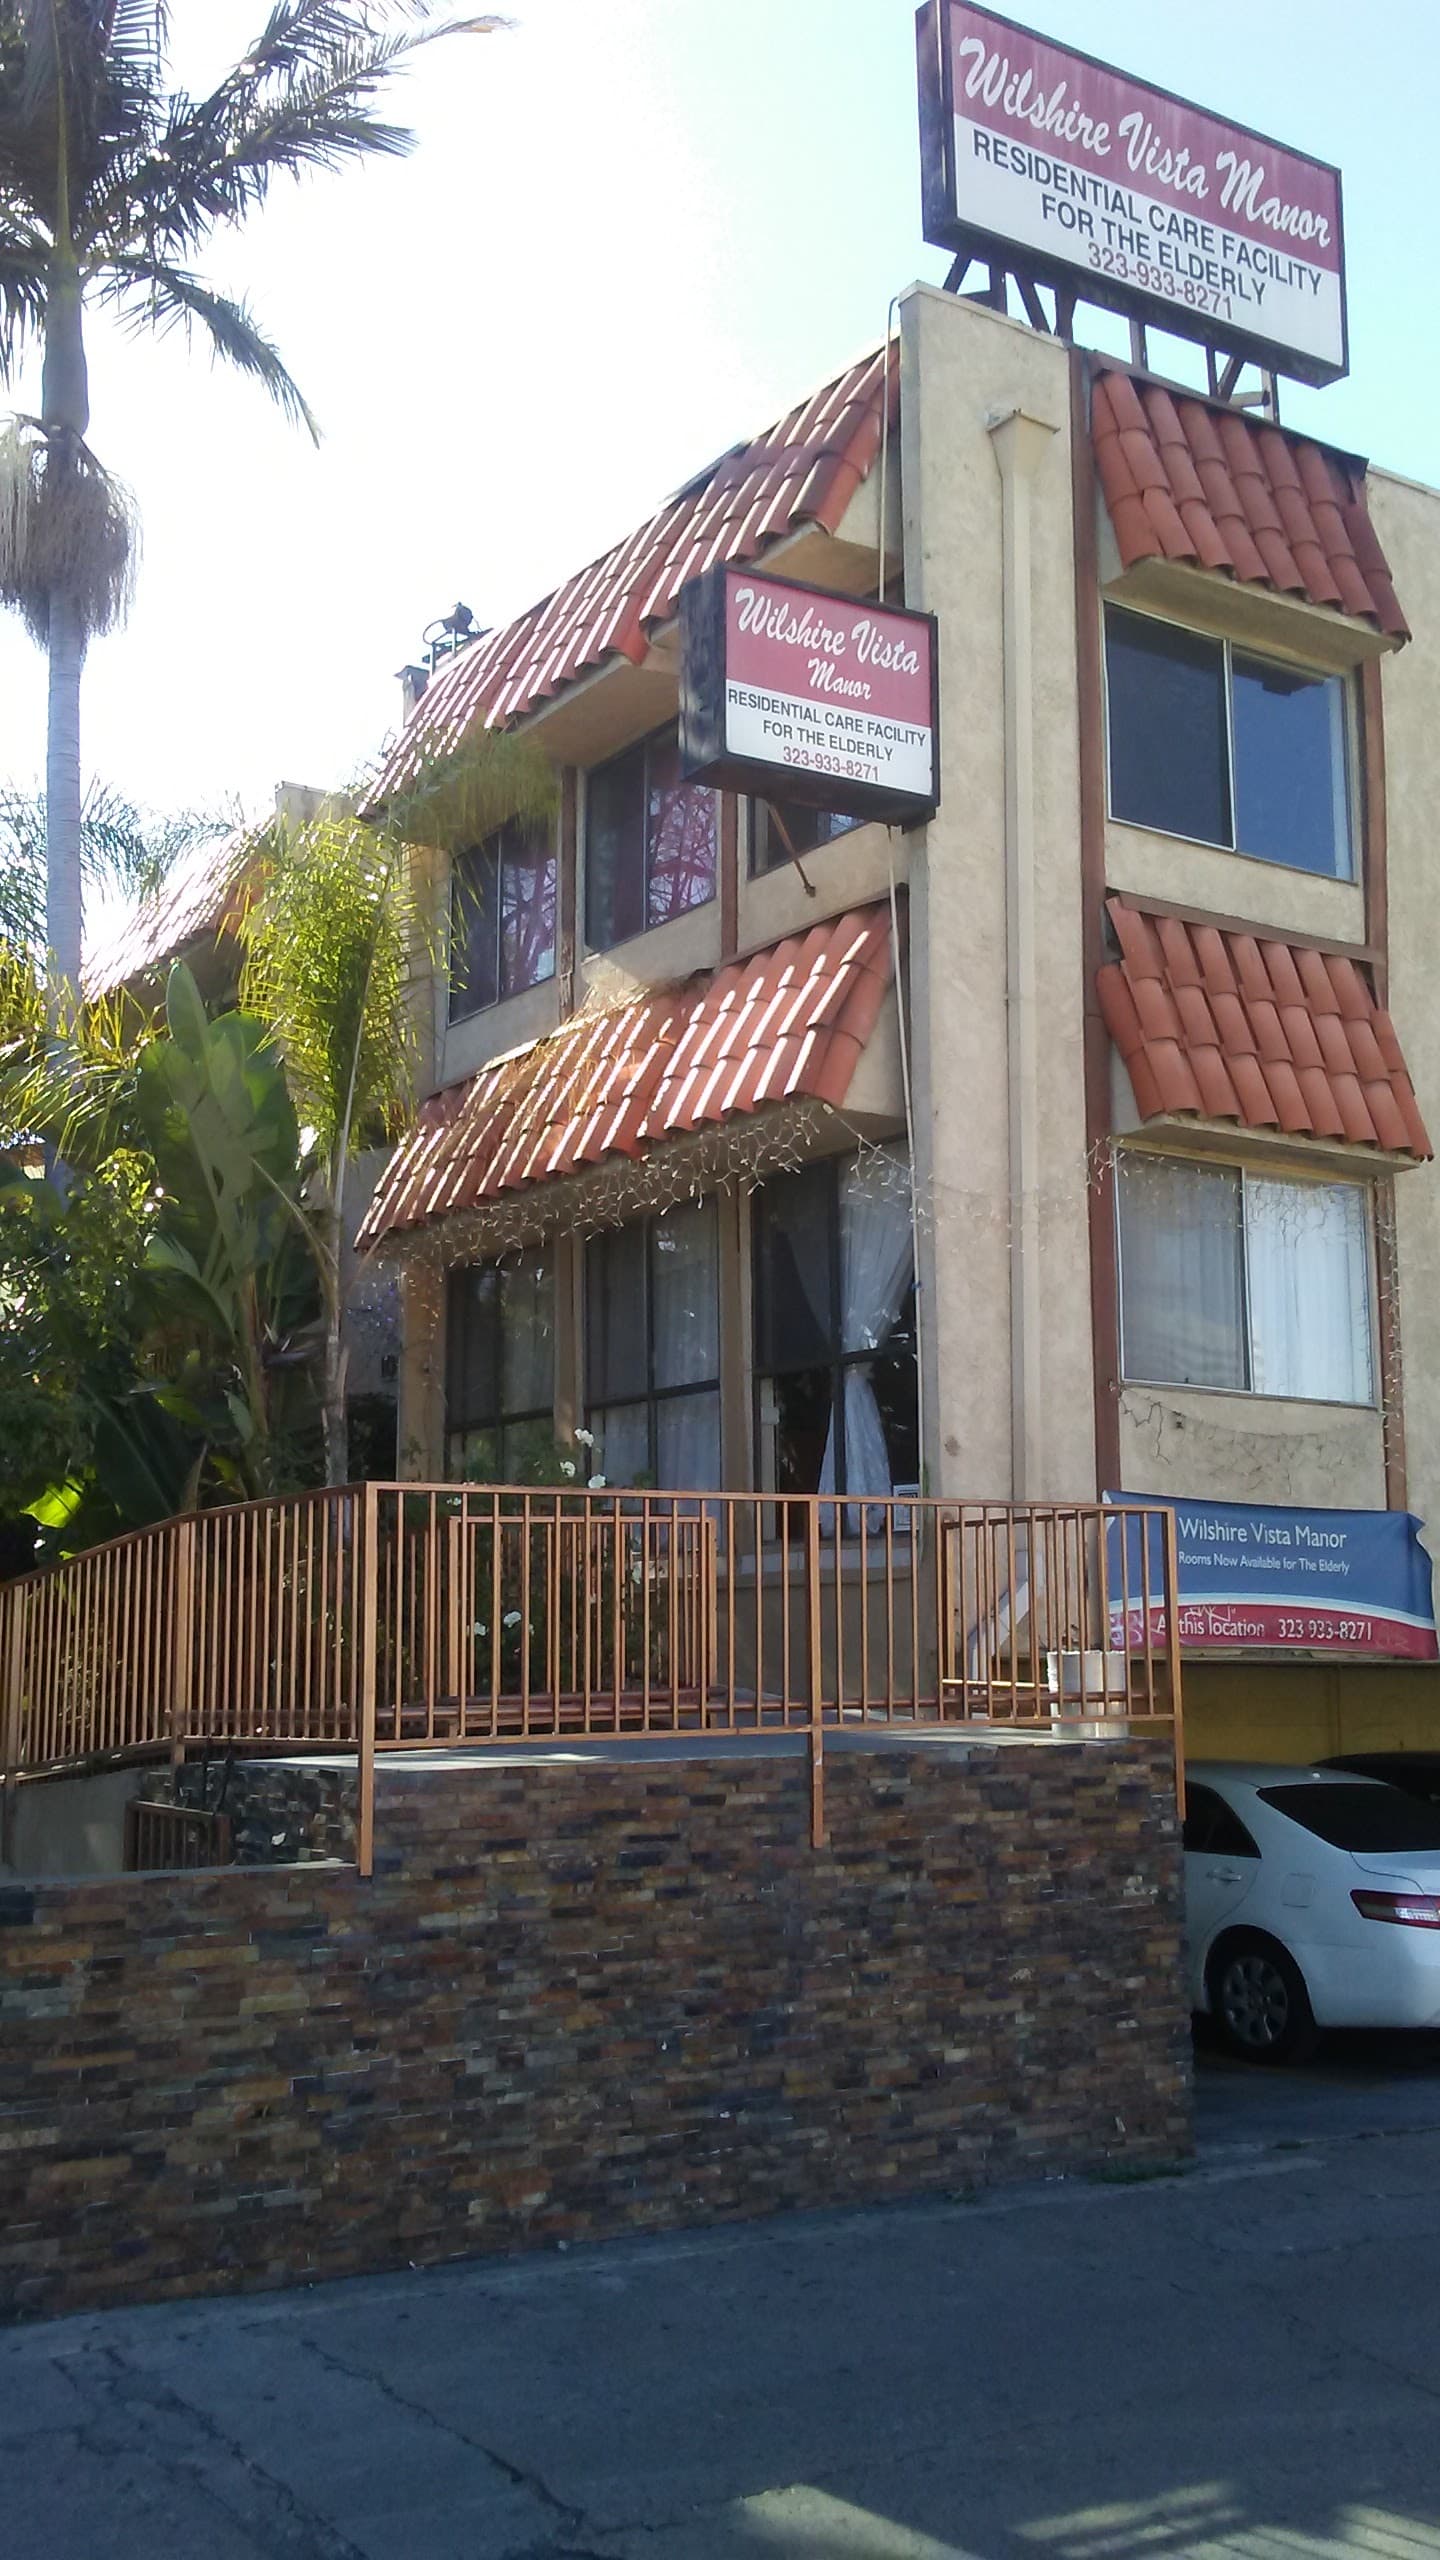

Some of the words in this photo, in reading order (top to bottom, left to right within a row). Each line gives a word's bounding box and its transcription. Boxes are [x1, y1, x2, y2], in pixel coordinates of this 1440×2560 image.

[960, 36, 1111, 156] Wilshire
[1119, 112, 1209, 201] Vista
[1216, 151, 1330, 248] Manor
[973, 129, 1142, 224] RESIDENTIAL
[1149, 207, 1214, 253] CARE
[1222, 235, 1322, 296] FACILITY
[1042, 194, 1094, 237] FOR
[1101, 219, 1151, 260] THE
[1159, 243, 1266, 305] ELDERLY
[1088, 243, 1233, 320] 323-933-8271
[735, 588, 846, 655] Wilshire
[851, 620, 920, 675] Vista
[808, 658, 871, 700] Manor
[728, 688, 821, 724] RESIDENTIAL
[825, 712, 863, 734] CARE
[867, 722, 926, 747] FACILITY
[763, 720, 793, 739] FOR
[797, 727, 825, 746] THE
[829, 735, 893, 761] ELDERLY
[783, 746, 880, 782] 323-933-8271
[1178, 1518, 1248, 1543] Wilshire
[1250, 1523, 1291, 1545] Vista
[1295, 1526, 1347, 1548] Manor
[1178, 1551, 1212, 1566] Rooms
[1240, 1555, 1281, 1570] Available
[1283, 1557, 1297, 1571] for
[1299, 1558, 1317, 1572] The
[1319, 1559, 1350, 1575] Elderly
[1179, 1615, 1205, 1635] this
[1208, 1615, 1265, 1638] location
[1278, 1618, 1304, 1639] 323
[1308, 1620, 1372, 1641] 933-8271
